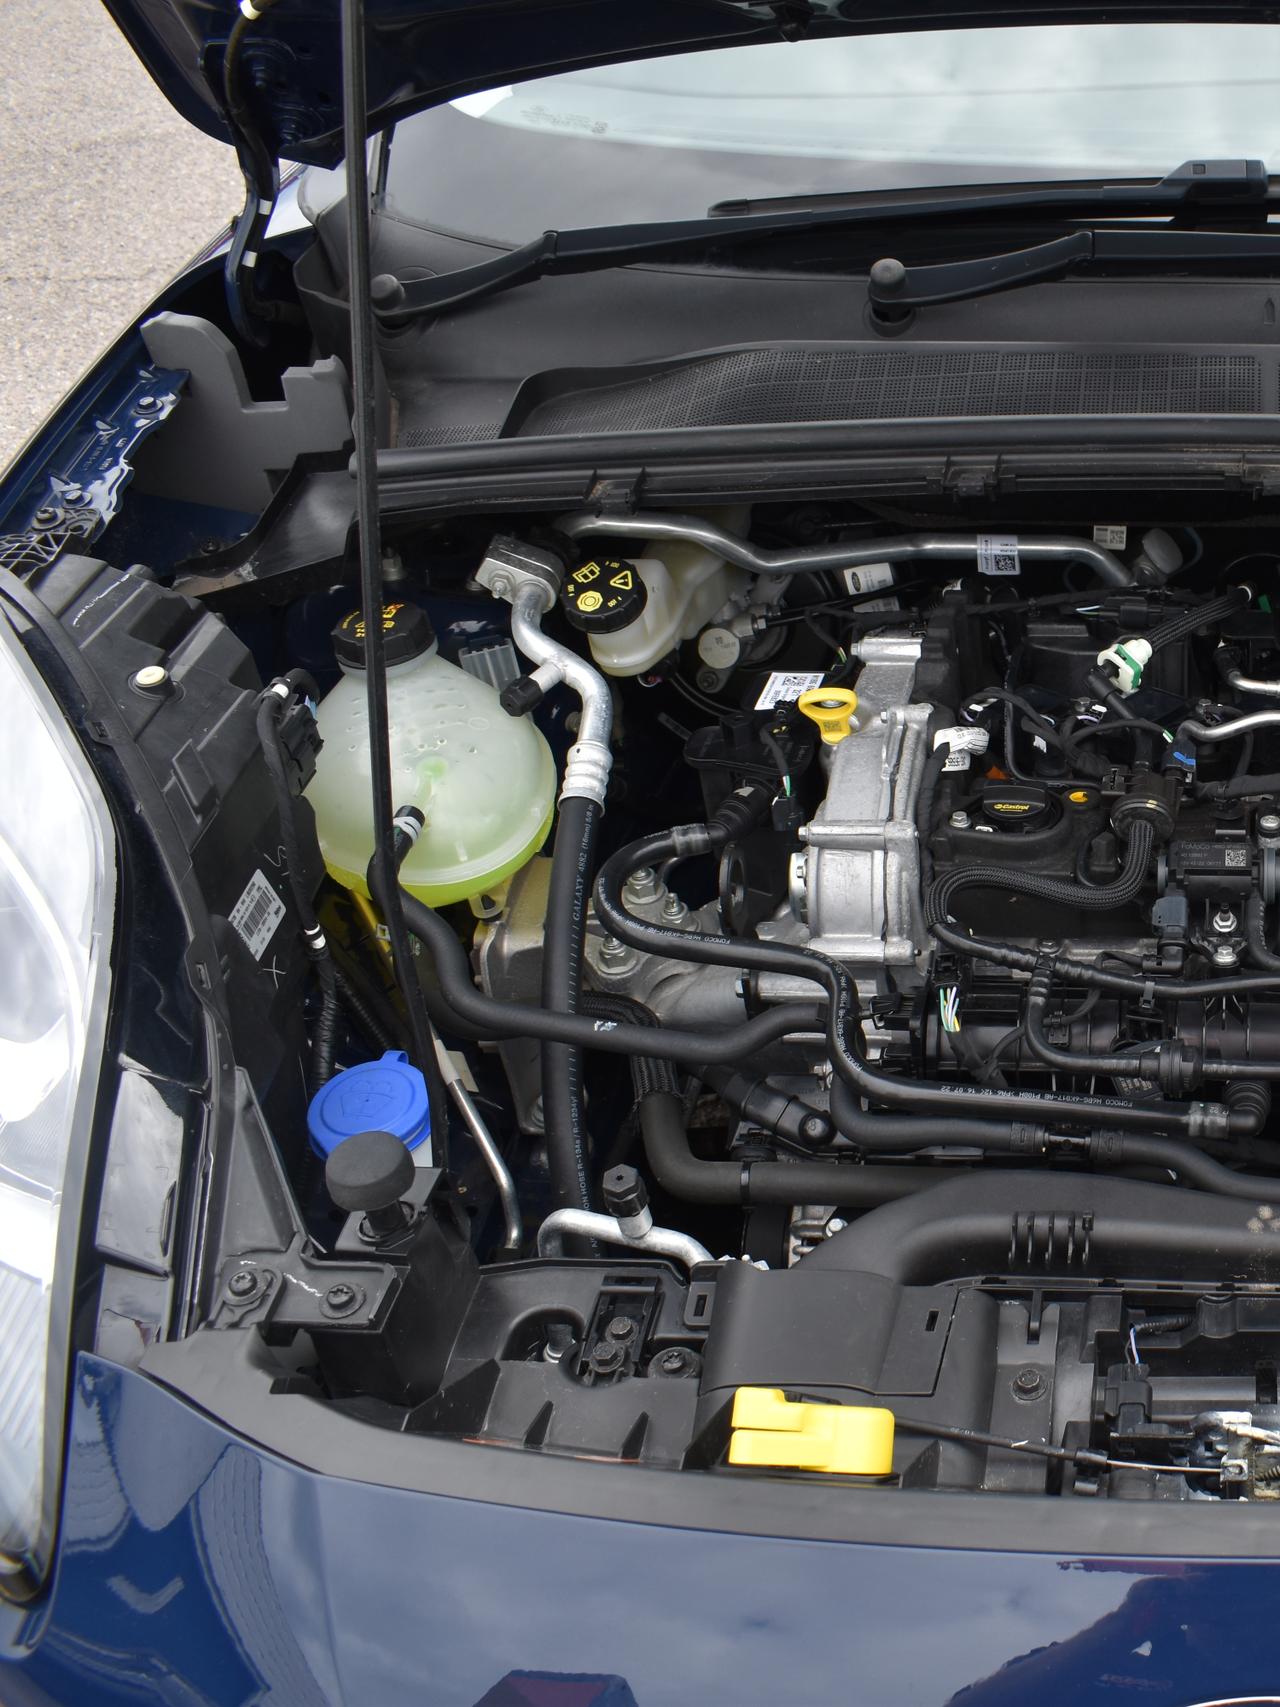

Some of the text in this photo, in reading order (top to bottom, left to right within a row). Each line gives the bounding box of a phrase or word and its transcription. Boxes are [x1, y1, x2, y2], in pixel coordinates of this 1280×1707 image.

[1003, 803, 1030, 811] Castrol
[573, 875, 585, 921] GALAXY
[1105, 1099, 1133, 1108] FOMOCO
[578, 1171, 586, 1194] HOSE
